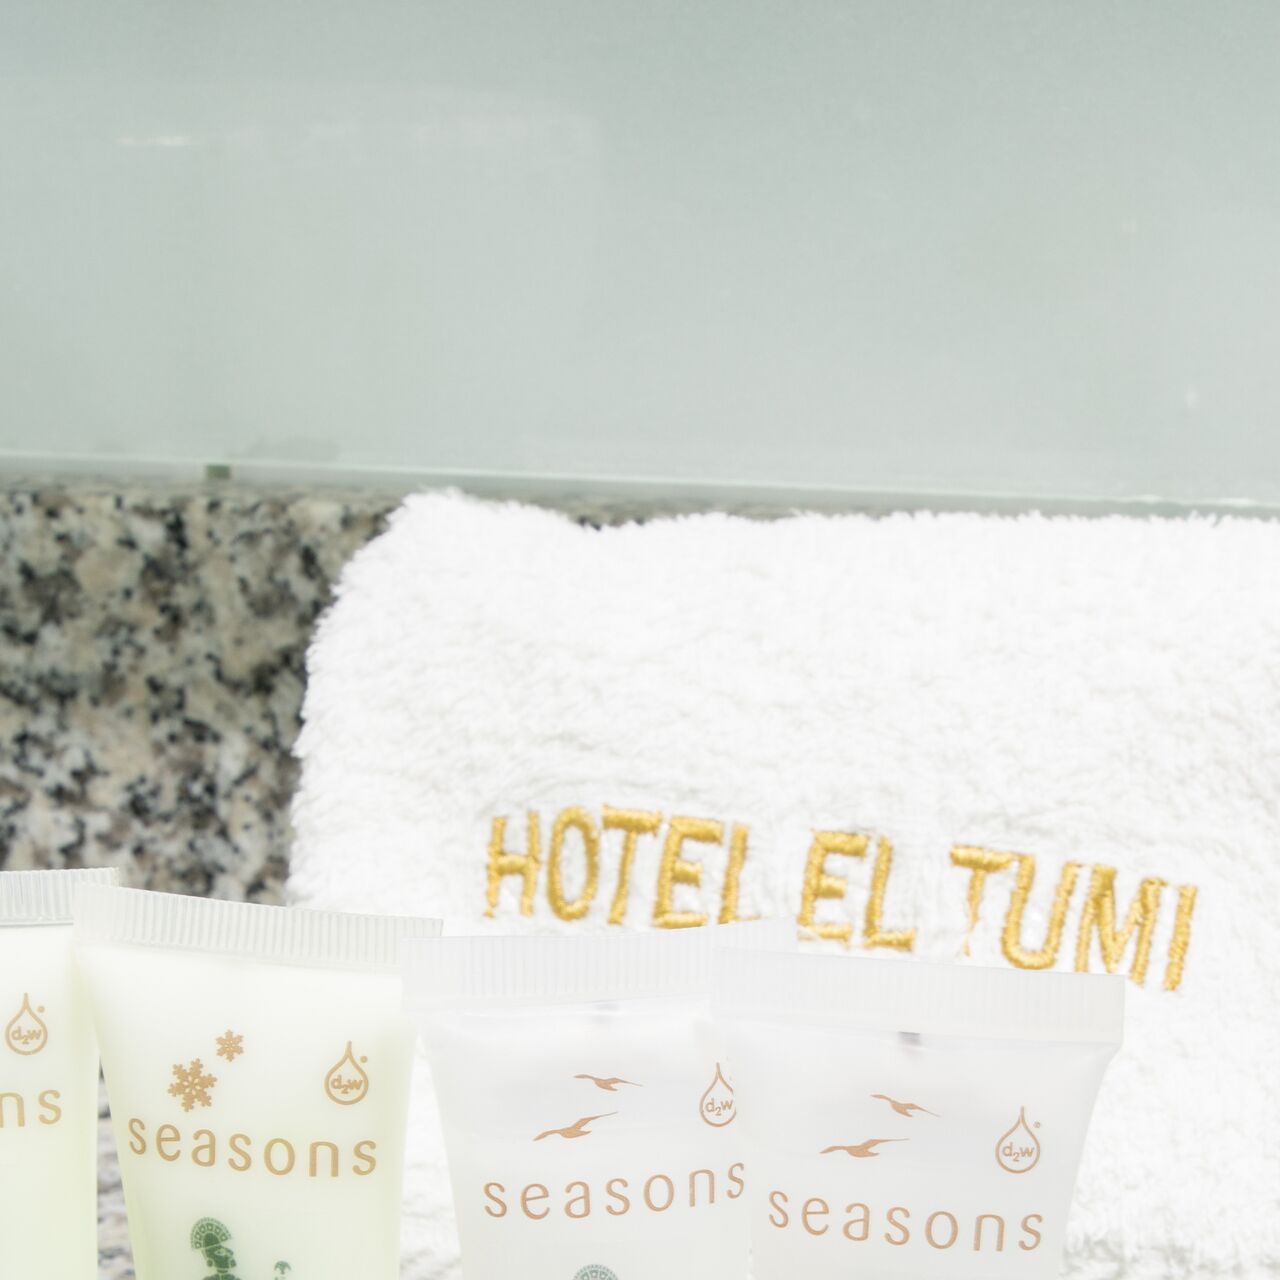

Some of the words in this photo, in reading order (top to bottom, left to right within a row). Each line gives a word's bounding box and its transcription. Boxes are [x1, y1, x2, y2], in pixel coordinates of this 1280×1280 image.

[482, 803, 762, 929] HOTEL
[796, 828, 916, 952] EL
[949, 843, 1199, 993] TUMI
[127, 1117, 378, 1178] seasons
[483, 1162, 745, 1220] seasons
[769, 1190, 1044, 1252] seasons
